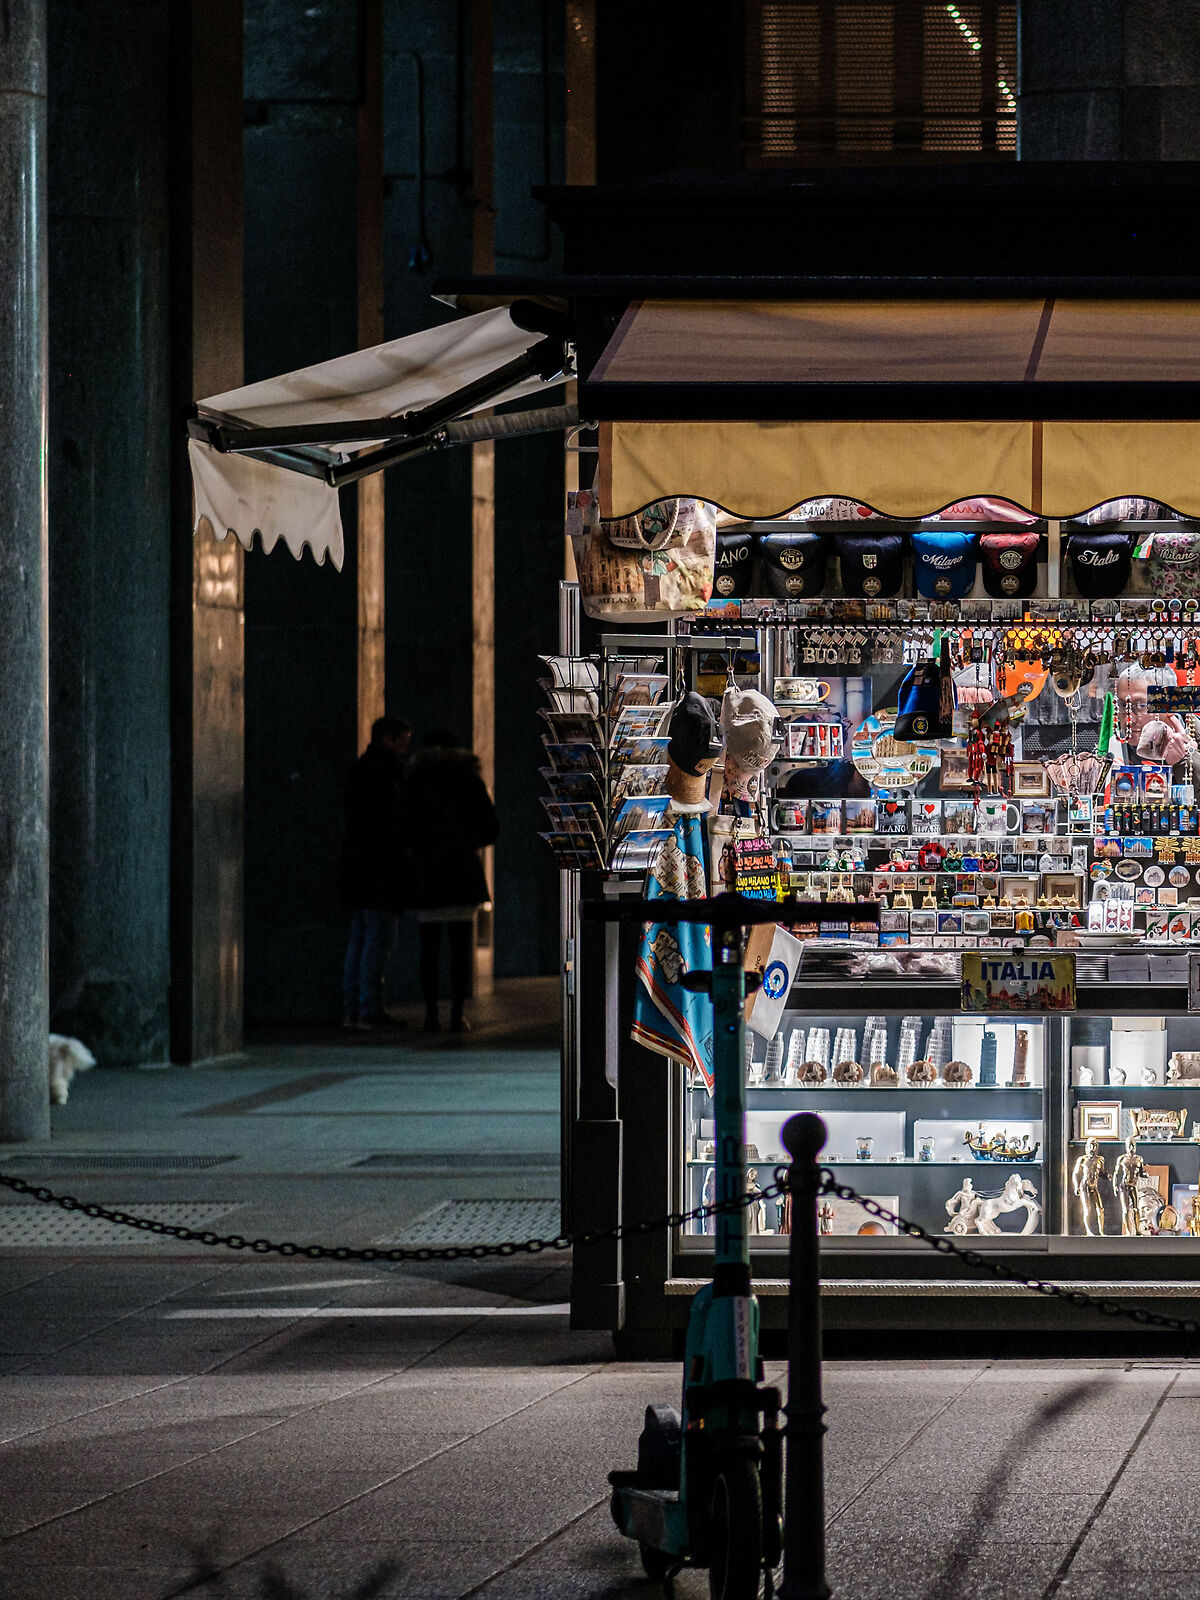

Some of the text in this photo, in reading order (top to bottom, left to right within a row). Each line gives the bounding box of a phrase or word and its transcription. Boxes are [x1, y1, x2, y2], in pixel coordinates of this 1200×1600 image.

[716, 547, 748, 564] LANO
[922, 553, 963, 567] Milano
[1078, 549, 1120, 566] Italia
[1160, 548, 1199, 563] Milano
[599, 596, 637, 605] MILANO
[803, 647, 861, 664] BUONE
[881, 803, 886, 814] I
[919, 803, 925, 814] I
[981, 962, 1055, 981] ITALIA
